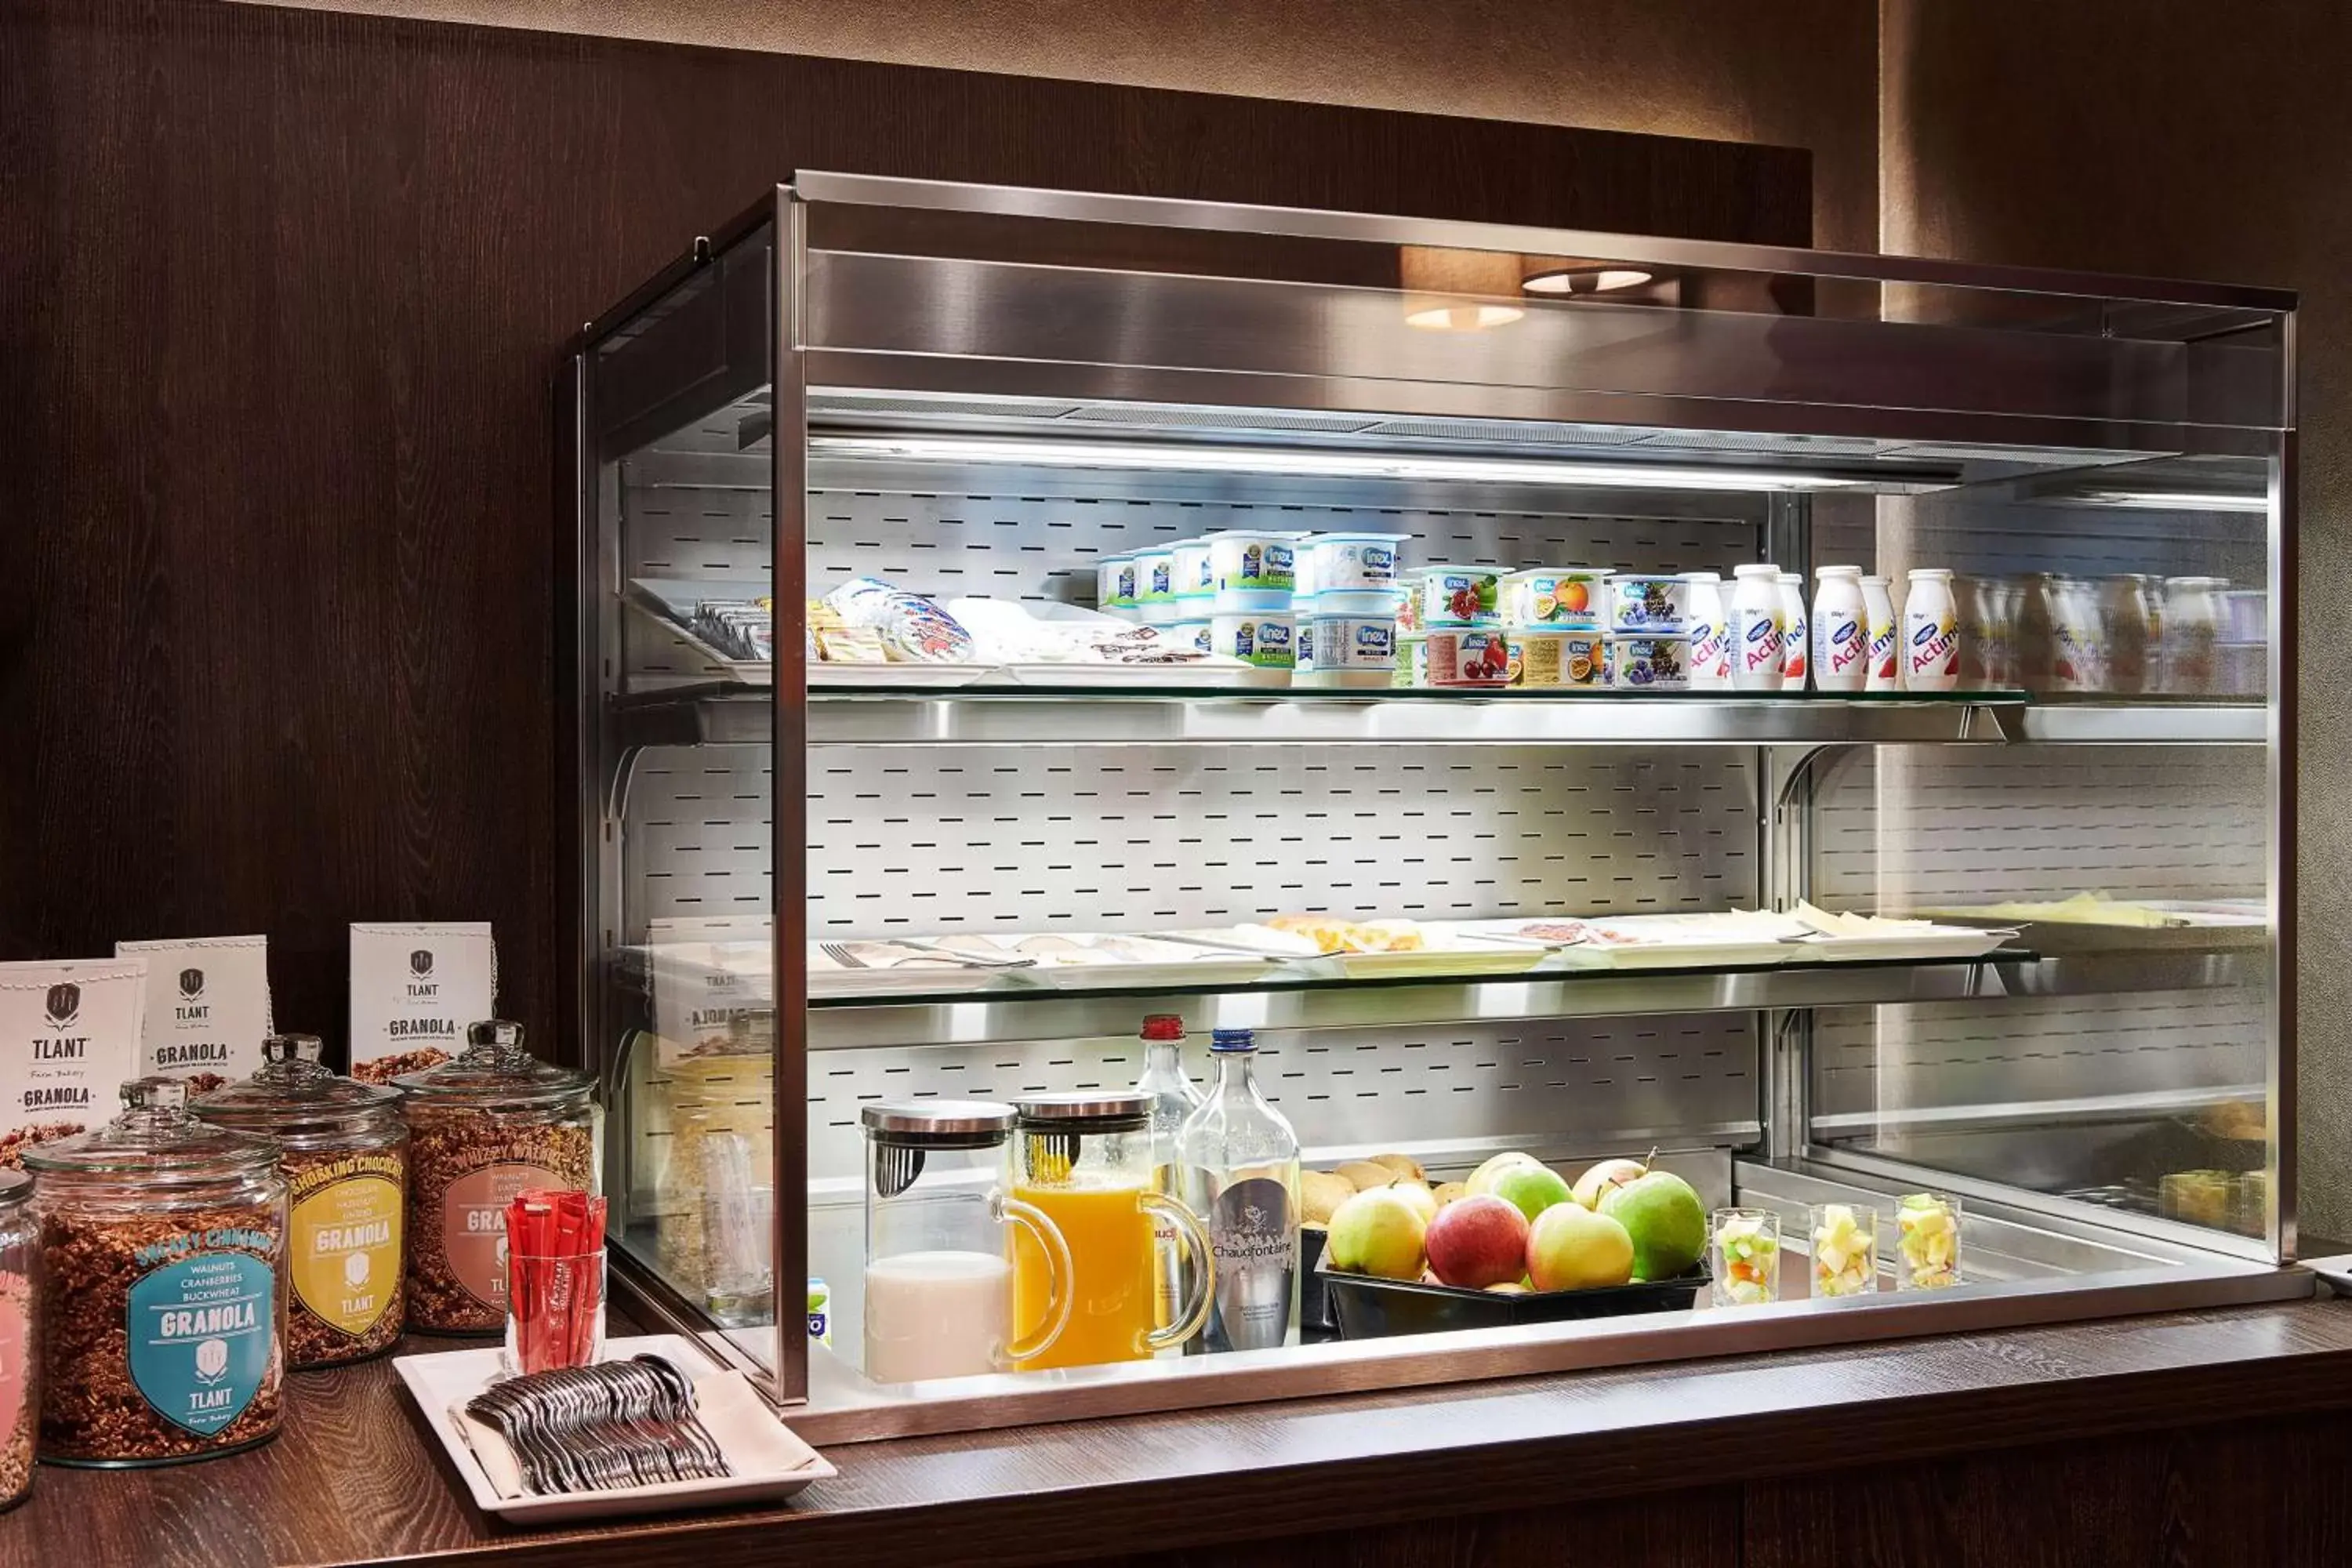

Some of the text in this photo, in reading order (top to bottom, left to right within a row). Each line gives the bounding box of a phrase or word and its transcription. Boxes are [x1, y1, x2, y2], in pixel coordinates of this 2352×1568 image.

[1367, 550, 1391, 565] inex
[1263, 625, 1288, 641] inex
[1362, 627, 1387, 643] inex
[407, 984, 439, 996] TLANT
[176, 1006, 210, 1020] TLANT
[390, 1019, 455, 1036] GRANOLA
[32, 1038, 87, 1059] TLANT
[157, 1044, 227, 1065] GRANOLA
[24, 1087, 89, 1107] GRANOLA
[291, 1160, 355, 1196] SHOCKING
[317, 1220, 390, 1251] GRANOLA
[191, 1261, 235, 1274] WALNUTS
[181, 1273, 243, 1288] CRANBERRIES
[183, 1287, 240, 1301] BUCKWHEAT
[342, 1294, 374, 1315] TLANT
[161, 1302, 255, 1337] GRANOLA
[189, 1388, 233, 1410] TLANT
